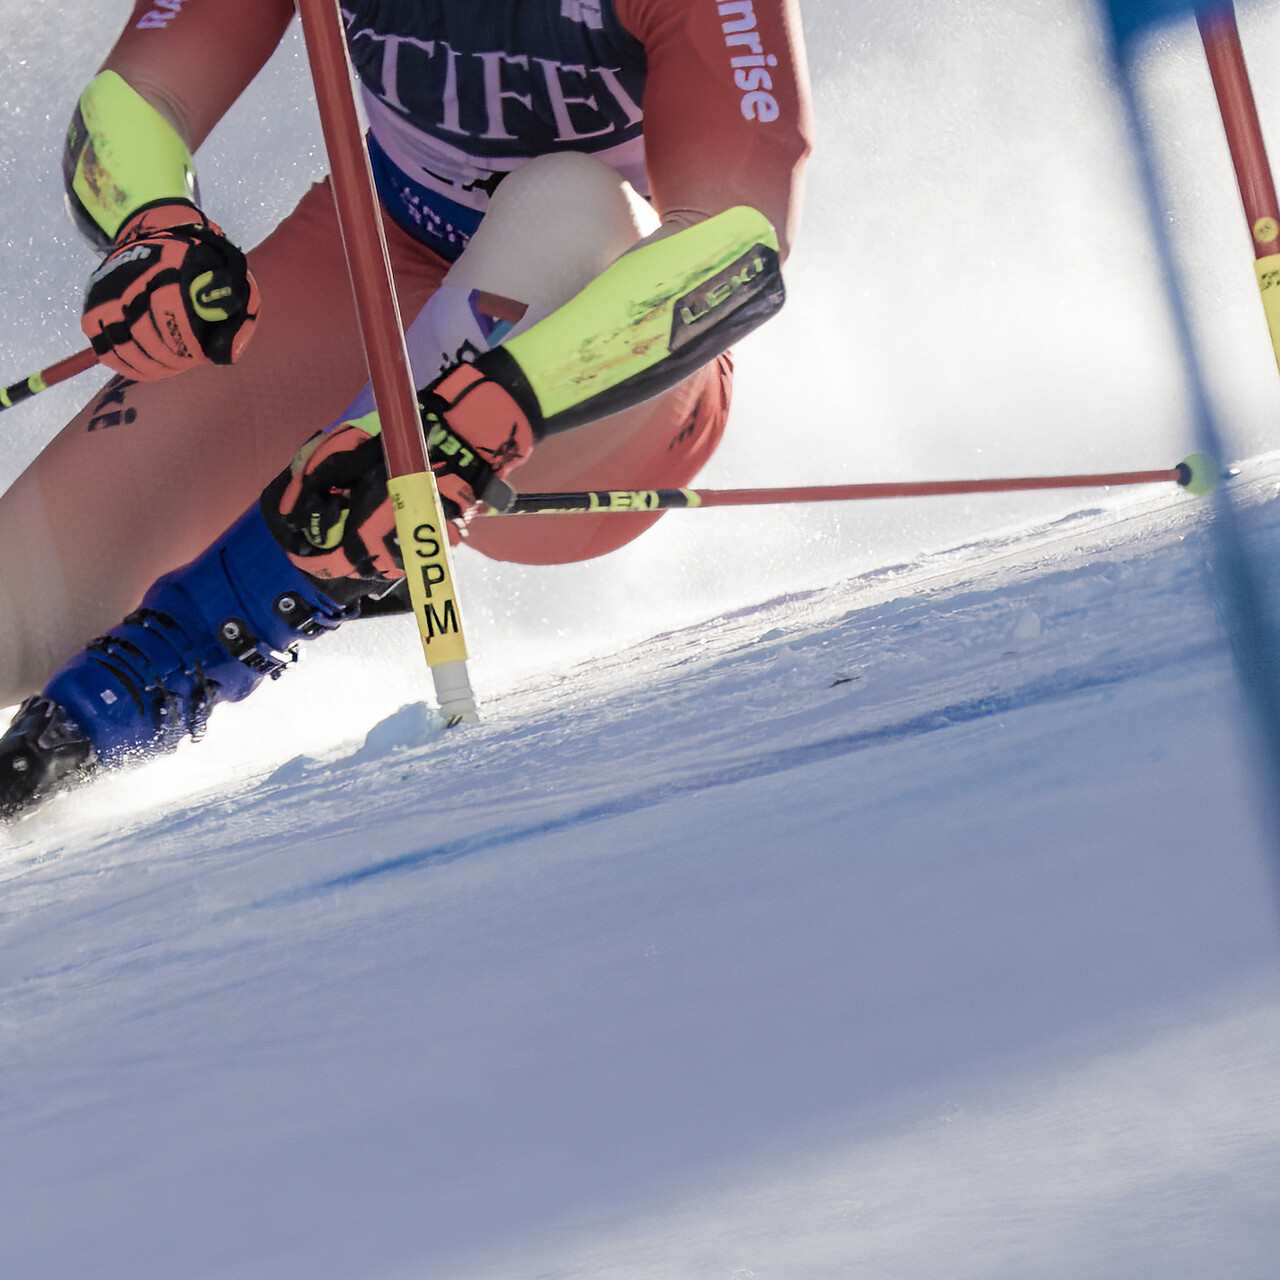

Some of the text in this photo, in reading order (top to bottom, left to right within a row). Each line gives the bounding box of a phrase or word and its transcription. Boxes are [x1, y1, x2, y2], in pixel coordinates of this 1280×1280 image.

[680, 256, 764, 325] LEKI
[588, 490, 660, 512] LEKI
[413, 523, 459, 639] SPM
